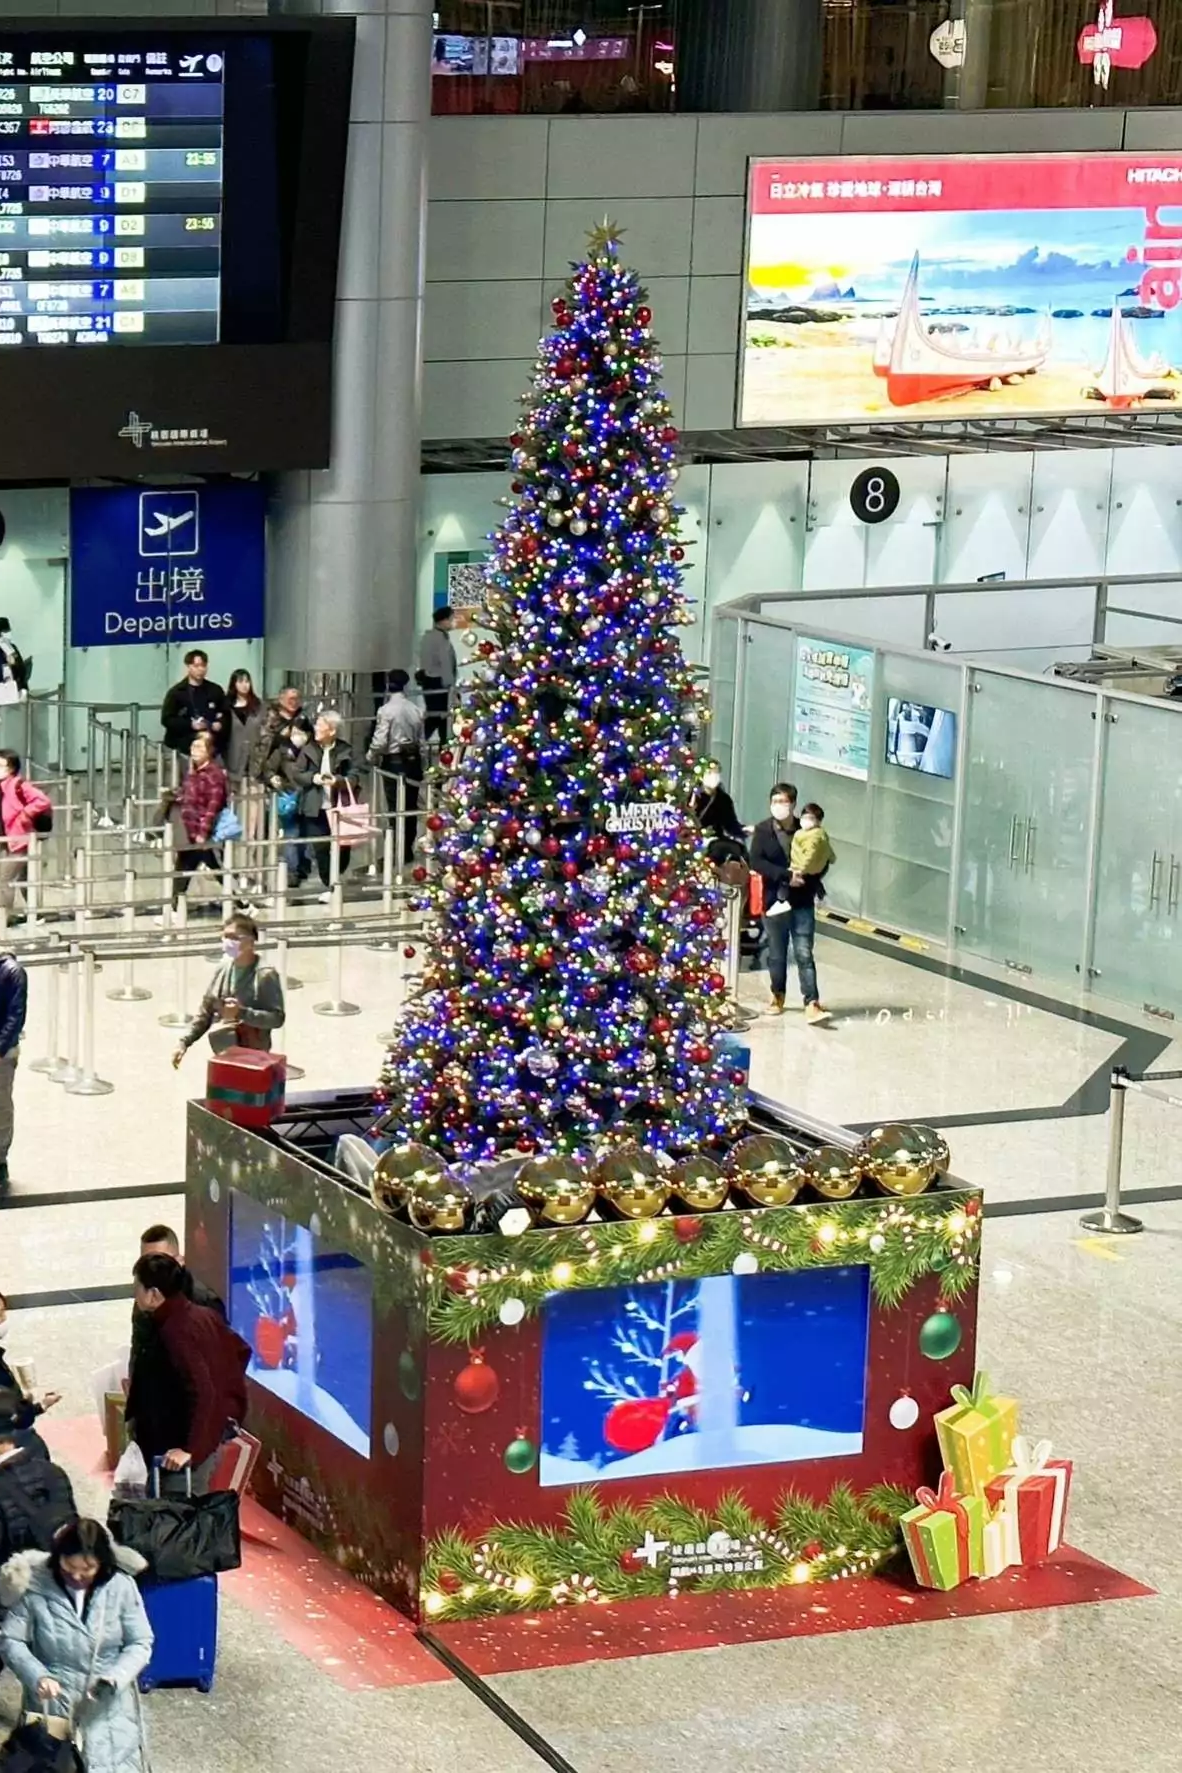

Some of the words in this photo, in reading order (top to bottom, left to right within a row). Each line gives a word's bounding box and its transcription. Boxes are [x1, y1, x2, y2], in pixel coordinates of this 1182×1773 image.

[97, 88, 114, 100] 20
[123, 88, 139, 99] C7
[102, 155, 109, 166] 7
[1127, 167, 1182, 184] HITACH
[121, 219, 137, 230] D2
[99, 285, 108, 297] 7
[865, 476, 885, 513] 8
[135, 566, 205, 604] 出境
[104, 611, 233, 638] Departures
